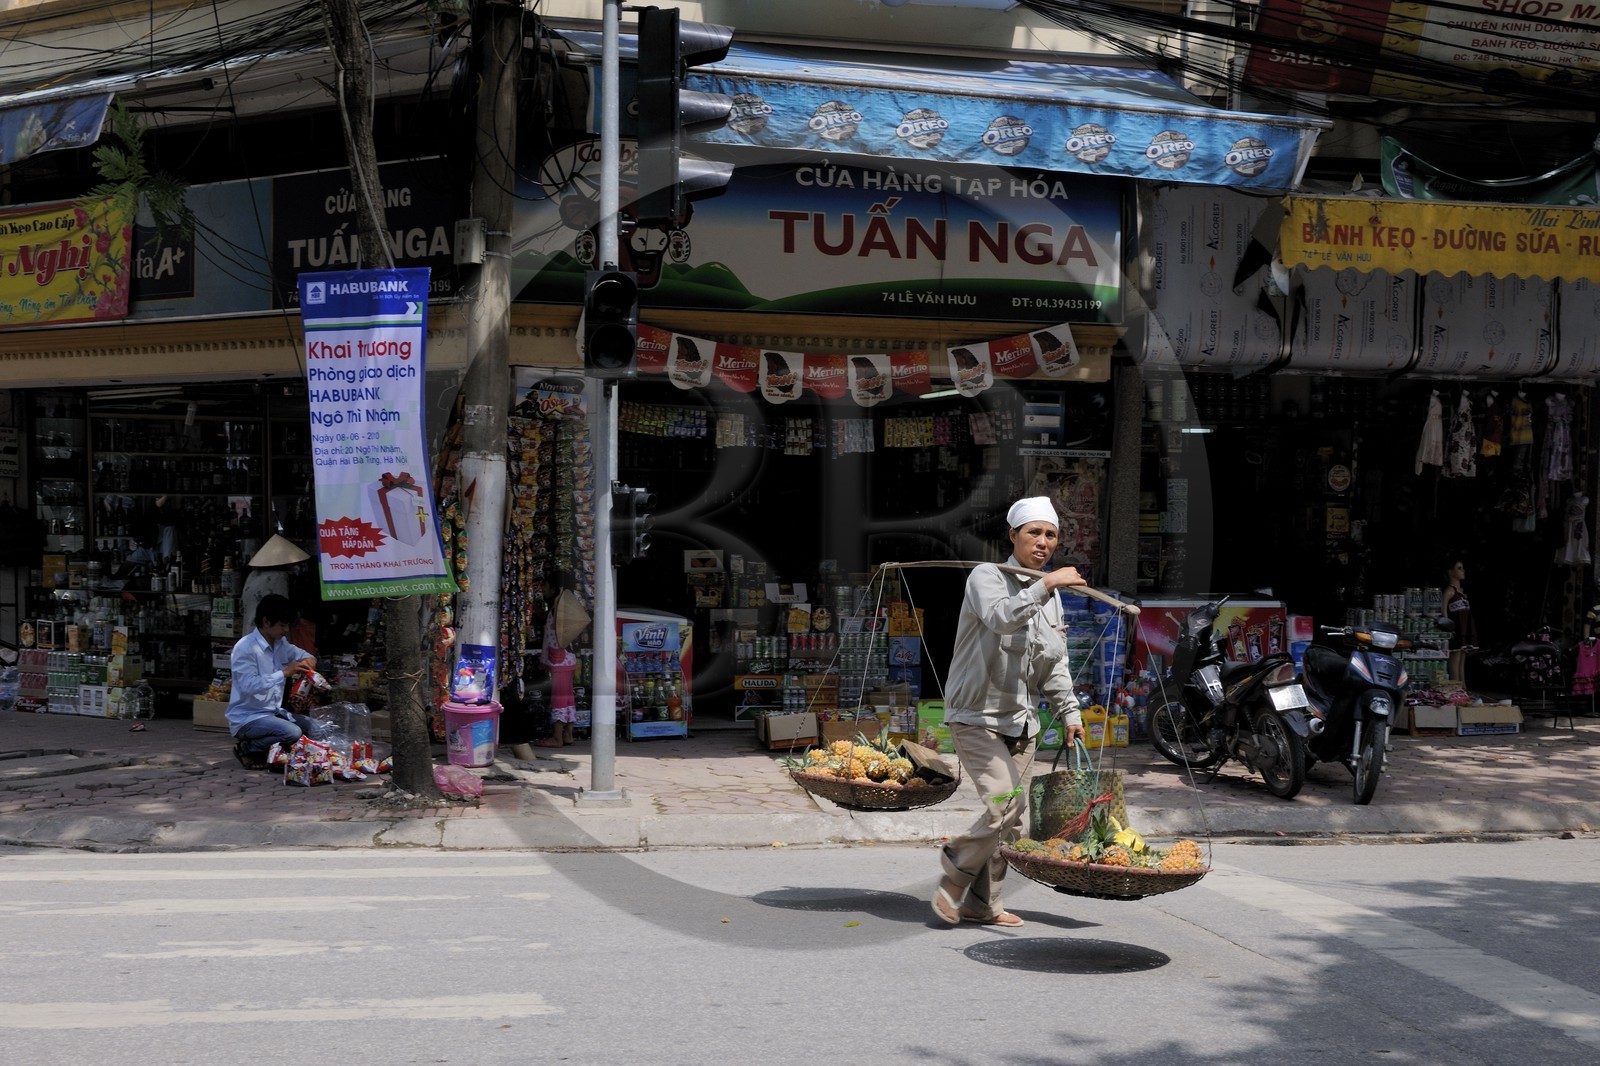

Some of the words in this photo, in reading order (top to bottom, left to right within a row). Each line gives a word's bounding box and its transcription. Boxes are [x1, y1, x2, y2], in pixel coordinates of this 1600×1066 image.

[1481, 0, 1563, 17] SHOP
[1447, 20, 1498, 31] CHUYÊN
[1501, 23, 1531, 32] KINH
[1535, 23, 1579, 33] DOANH
[1471, 38, 1506, 48] BÁNH
[809, 111, 862, 131] OREO
[896, 118, 948, 138] OREO
[982, 125, 1033, 145] OREO
[1065, 133, 1116, 153] OREO
[1145, 139, 1195, 158] OREO
[1225, 146, 1274, 167] OREO
[795, 158, 855, 188] CỬA
[863, 165, 942, 194] HÀNG
[950, 175, 1002, 201] TẠP
[1010, 172, 1069, 200] HÓA
[324, 187, 357, 215] CỬA
[32, 219, 53, 232] Cao
[768, 196, 948, 261] TUẤN
[968, 221, 1099, 268] NGA
[1206, 203, 1219, 250] ALCOREST
[1372, 226, 1416, 252] KẸO
[1433, 223, 1506, 251] ĐƯỜNG
[1516, 227, 1561, 254] SỮA
[8, 233, 92, 287] Nghị
[330, 280, 409, 295] HABUBANK
[882, 292, 896, 303] 74
[898, 291, 914, 303] LÊ
[916, 292, 945, 305] VĂN
[948, 294, 977, 306] HƯU
[1011, 297, 1033, 308] ĐT:
[1036, 298, 1103, 310] 04.39435199
[1391, 275, 1405, 322] ALCOREST
[1202, 310, 1218, 356] ALCOREST
[1333, 314, 1350, 360] ALCOREST
[308, 340, 351, 359] Khai
[358, 340, 411, 360] trương
[994, 347, 1031, 365] Merino
[716, 355, 757, 370] Merino
[806, 365, 845, 379] Merino
[891, 363, 928, 378] Merino
[309, 366, 356, 383] Phòng
[358, 366, 383, 382] giao
[386, 364, 416, 381] dịch
[309, 387, 381, 402] HABUBANK
[311, 410, 344, 427] Ngô
[347, 409, 362, 423] Thì
[366, 408, 401, 425] Nhậm
[312, 433, 334, 443] Ngày
[314, 447, 329, 458] Địa
[355, 445, 370, 456] Ngô
[315, 456, 338, 467] Quận
[340, 457, 351, 465] Hai
[353, 456, 364, 465] Bà
[383, 455, 394, 465] Hà
[395, 455, 408, 466] Nội
[319, 527, 337, 538] QUÀ
[338, 526, 360, 539] TẶNG
[357, 535, 375, 549] DẪN
[330, 562, 355, 570] TRONG
[355, 560, 382, 569] THÁNG
[383, 560, 401, 568] KHAI
[402, 558, 434, 567] TRƯƠNG
[327, 581, 452, 597] www.habubank.com.vn
[744, 679, 775, 687] HALIDA
